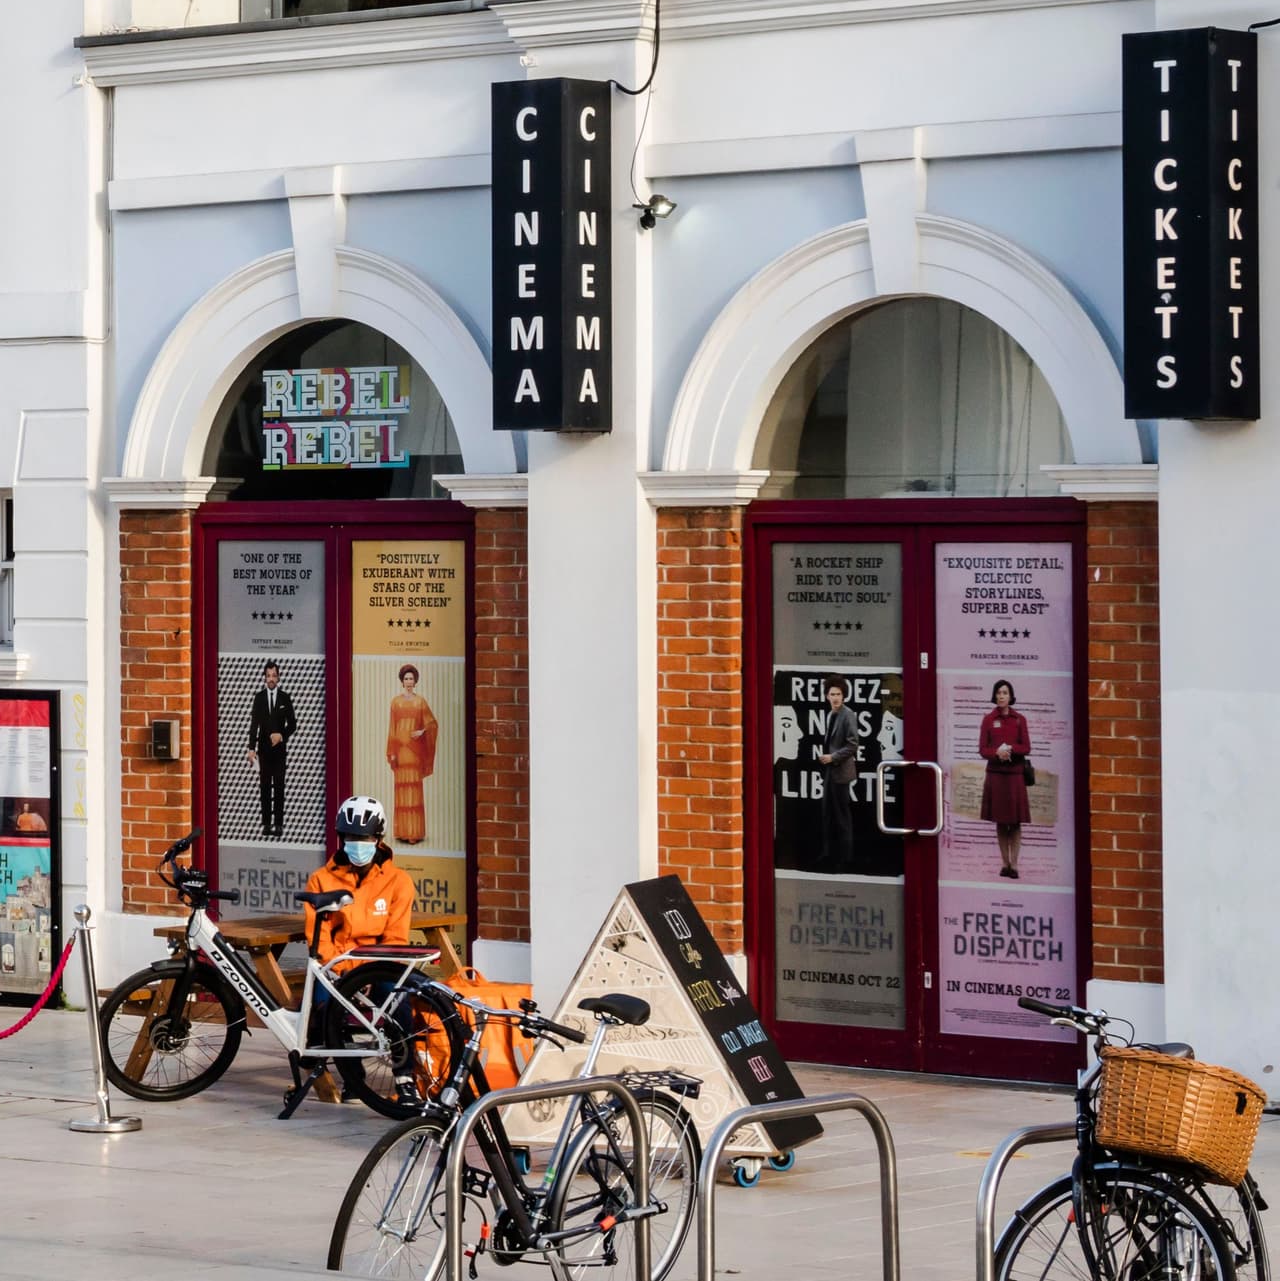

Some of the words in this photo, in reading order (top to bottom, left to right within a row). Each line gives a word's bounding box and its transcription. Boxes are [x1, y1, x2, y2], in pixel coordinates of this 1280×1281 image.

[1153, 60, 1178, 389] TICKETS
[1227, 59, 1243, 388] TICKETS
[510, 106, 544, 403] CINEMA
[576, 106, 600, 403] CINEMA
[263, 366, 410, 417] REBEL
[263, 420, 410, 470] REBEL
[267, 554, 280, 563] OF
[283, 554, 302, 564] THE
[807, 558, 852, 568] ROCKET
[856, 558, 883, 568] SHIP
[233, 569, 256, 579] BEST
[260, 570, 296, 579] MOVIES
[300, 570, 312, 579] OF
[363, 568, 424, 578] EXUBERANT
[428, 569, 455, 578] WITH
[796, 575, 823, 585] RIDE
[827, 575, 842, 585] TO
[846, 575, 878, 585] YOUR
[975, 573, 1032, 583] ECLECTIC
[247, 585, 265, 595] THE
[373, 583, 405, 592] STARS
[409, 583, 421, 592] OF
[425, 583, 445, 592] THE
[965, 588, 1044, 600] STORYLINES,
[369, 597, 404, 607] SILVER
[788, 592, 852, 603] CINEMATIC
[962, 603, 1008, 613] SUPERB
[799, 903, 884, 927] FRENCH
[963, 912, 1053, 938] FRENCH
[790, 925, 893, 950] DISPATCH
[954, 935, 1063, 962] DISPATCH
[783, 970, 795, 980] IN
[800, 971, 855, 984] CINEMAS
[858, 975, 882, 986] OCT
[886, 977, 900, 988] 22
[222, 963, 269, 1017] zoomo
[946, 981, 960, 992] IN
[965, 982, 1022, 996] CINEMAS
[1026, 986, 1051, 998] OCT
[1056, 989, 1070, 1000] 22
